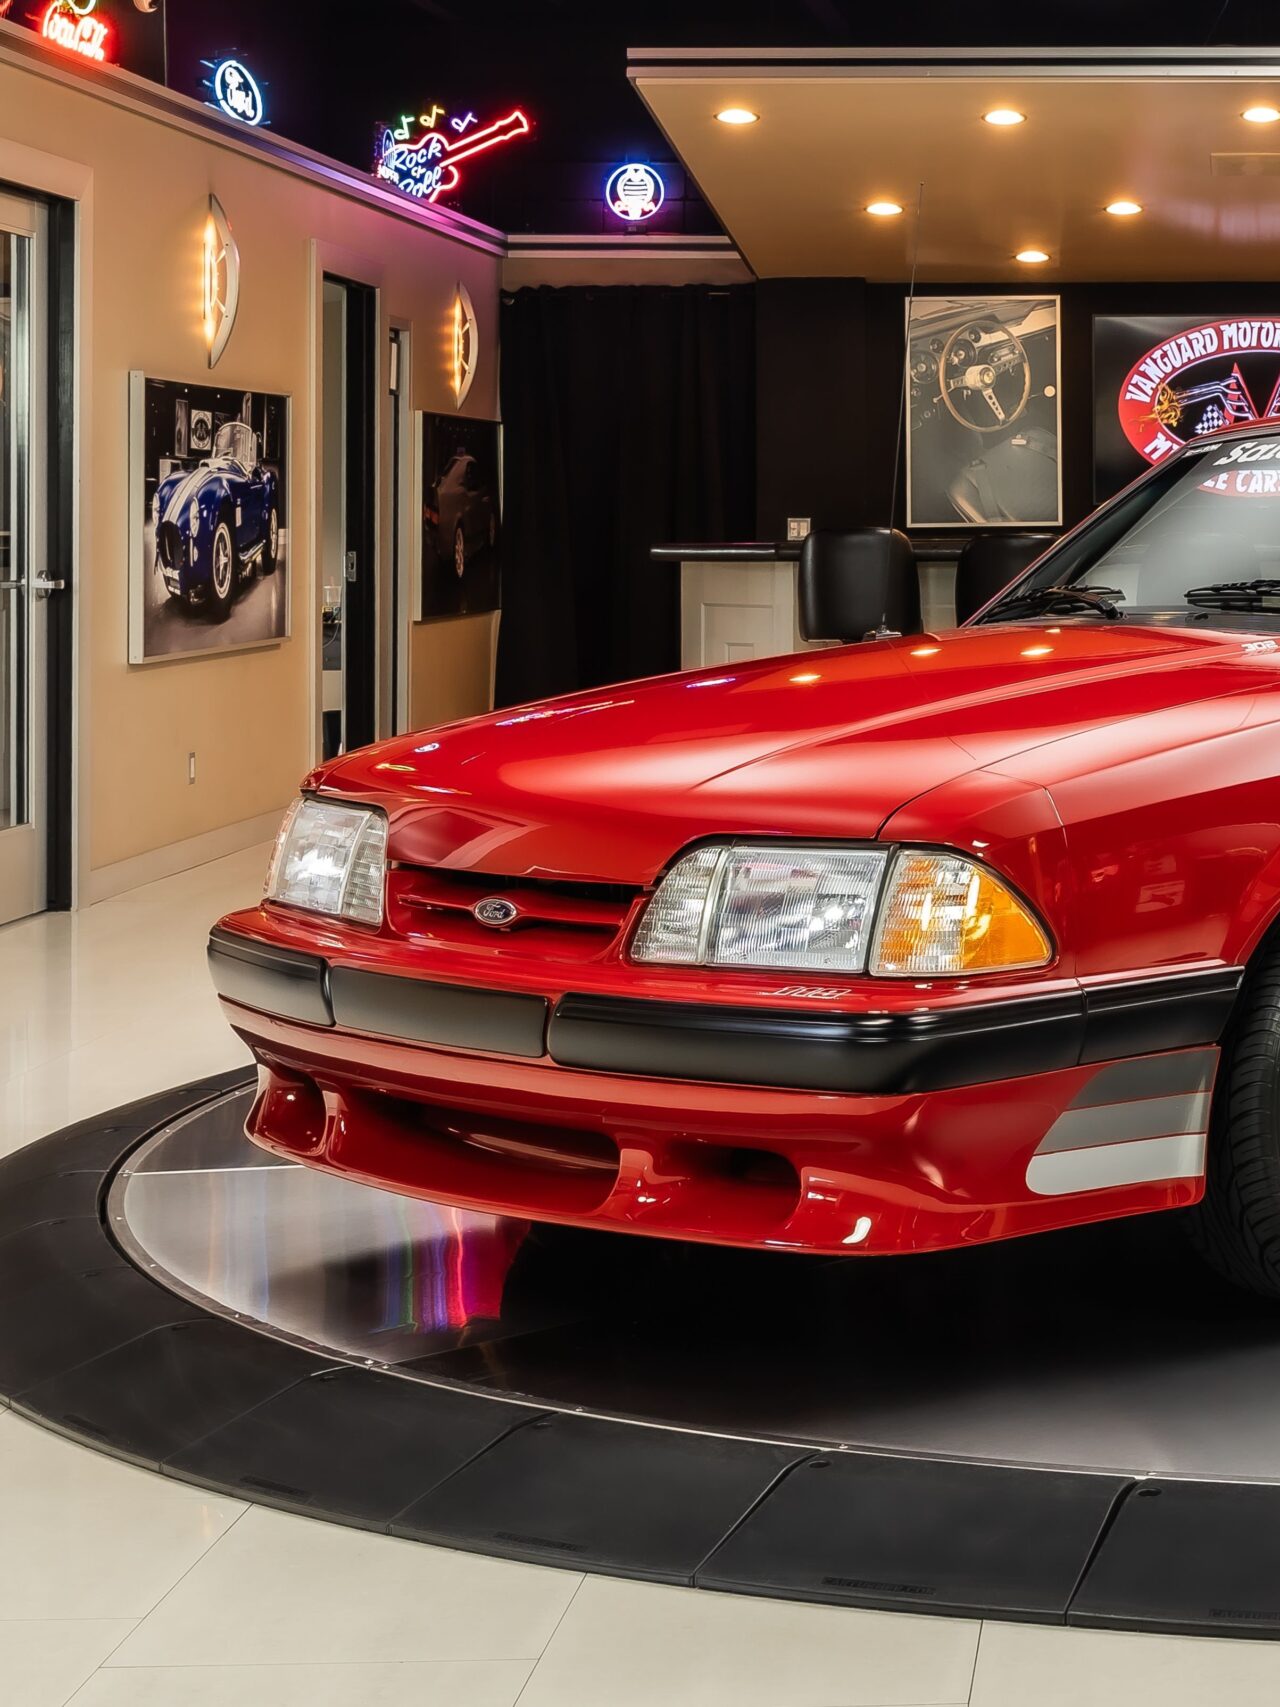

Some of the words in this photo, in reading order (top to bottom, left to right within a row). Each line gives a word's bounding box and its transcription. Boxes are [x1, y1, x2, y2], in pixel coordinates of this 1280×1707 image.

[393, 136, 442, 171] Rock
[1125, 327, 1218, 403] VANGUARD
[1241, 640, 1279, 652] 302
[482, 902, 506, 919] Ford
